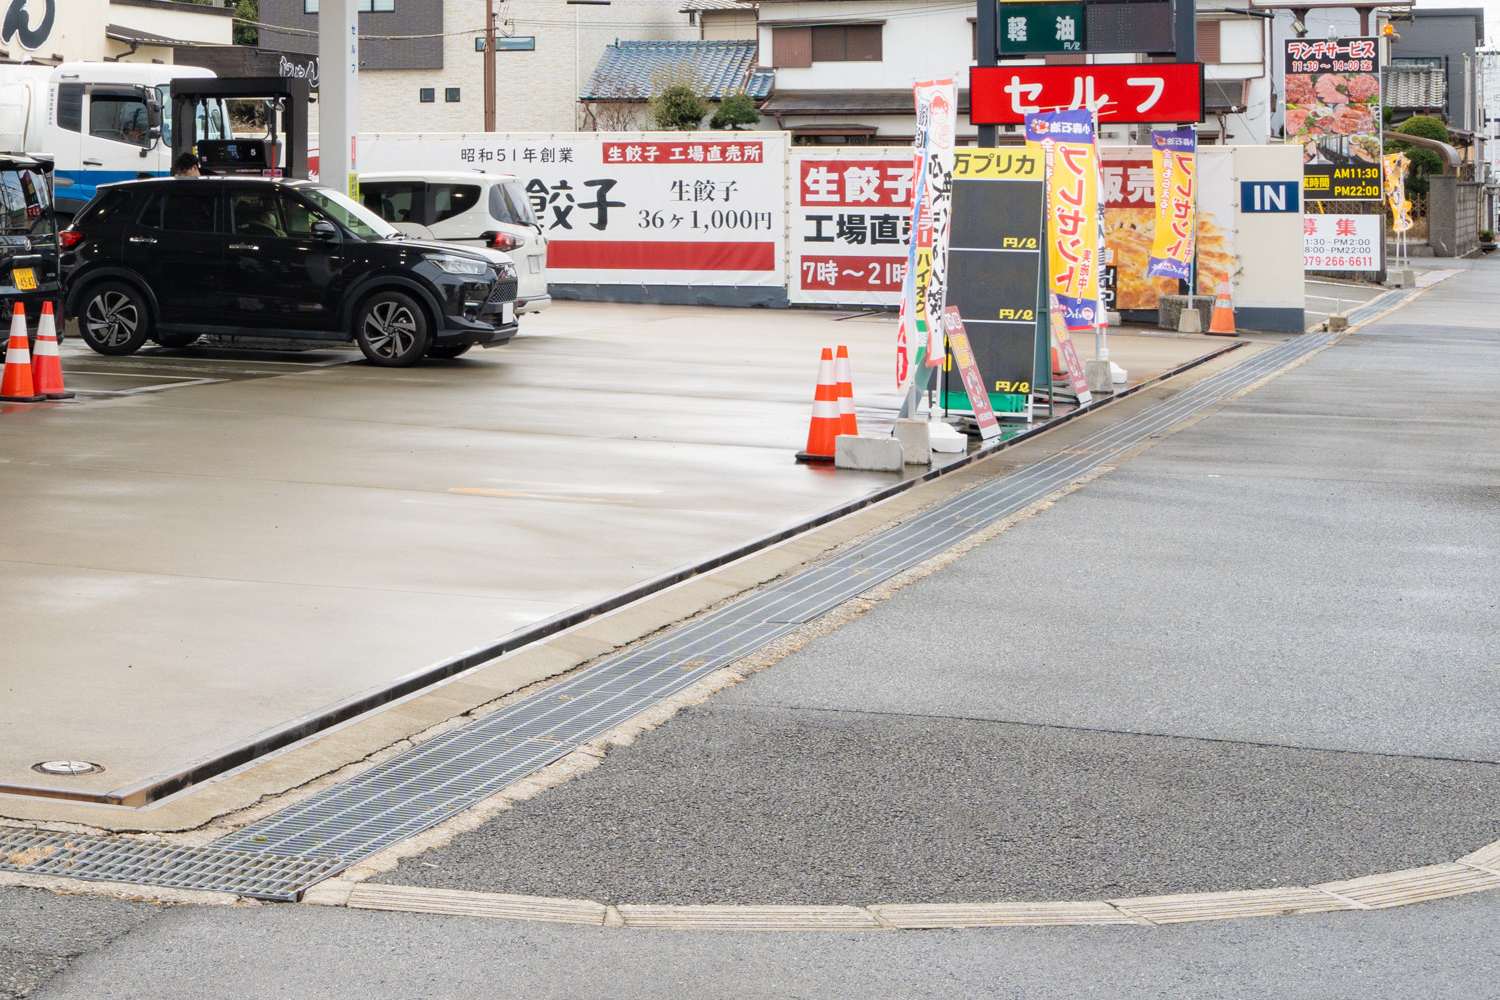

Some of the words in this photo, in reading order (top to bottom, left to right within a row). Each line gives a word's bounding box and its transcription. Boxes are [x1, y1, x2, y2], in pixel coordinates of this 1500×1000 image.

[1007, 15, 1075, 41] 軽油
[1288, 41, 1375, 59] ランチサービス
[1004, 75, 1165, 114] セルフ
[461, 147, 573, 164] 昭和51年創業
[608, 146, 659, 162] 生餃子
[669, 145, 761, 162] 工場直売所
[804, 167, 913, 203] 生餃子
[1334, 168, 1378, 179] AM11:30
[670, 179, 738, 202] 生餃子
[1254, 184, 1285, 210] IN
[1334, 186, 1379, 196] PM22:00
[526, 178, 626, 231] 餃子
[638, 209, 772, 233] 36ヶ1,000円
[916, 253, 931, 313] ハイオク
